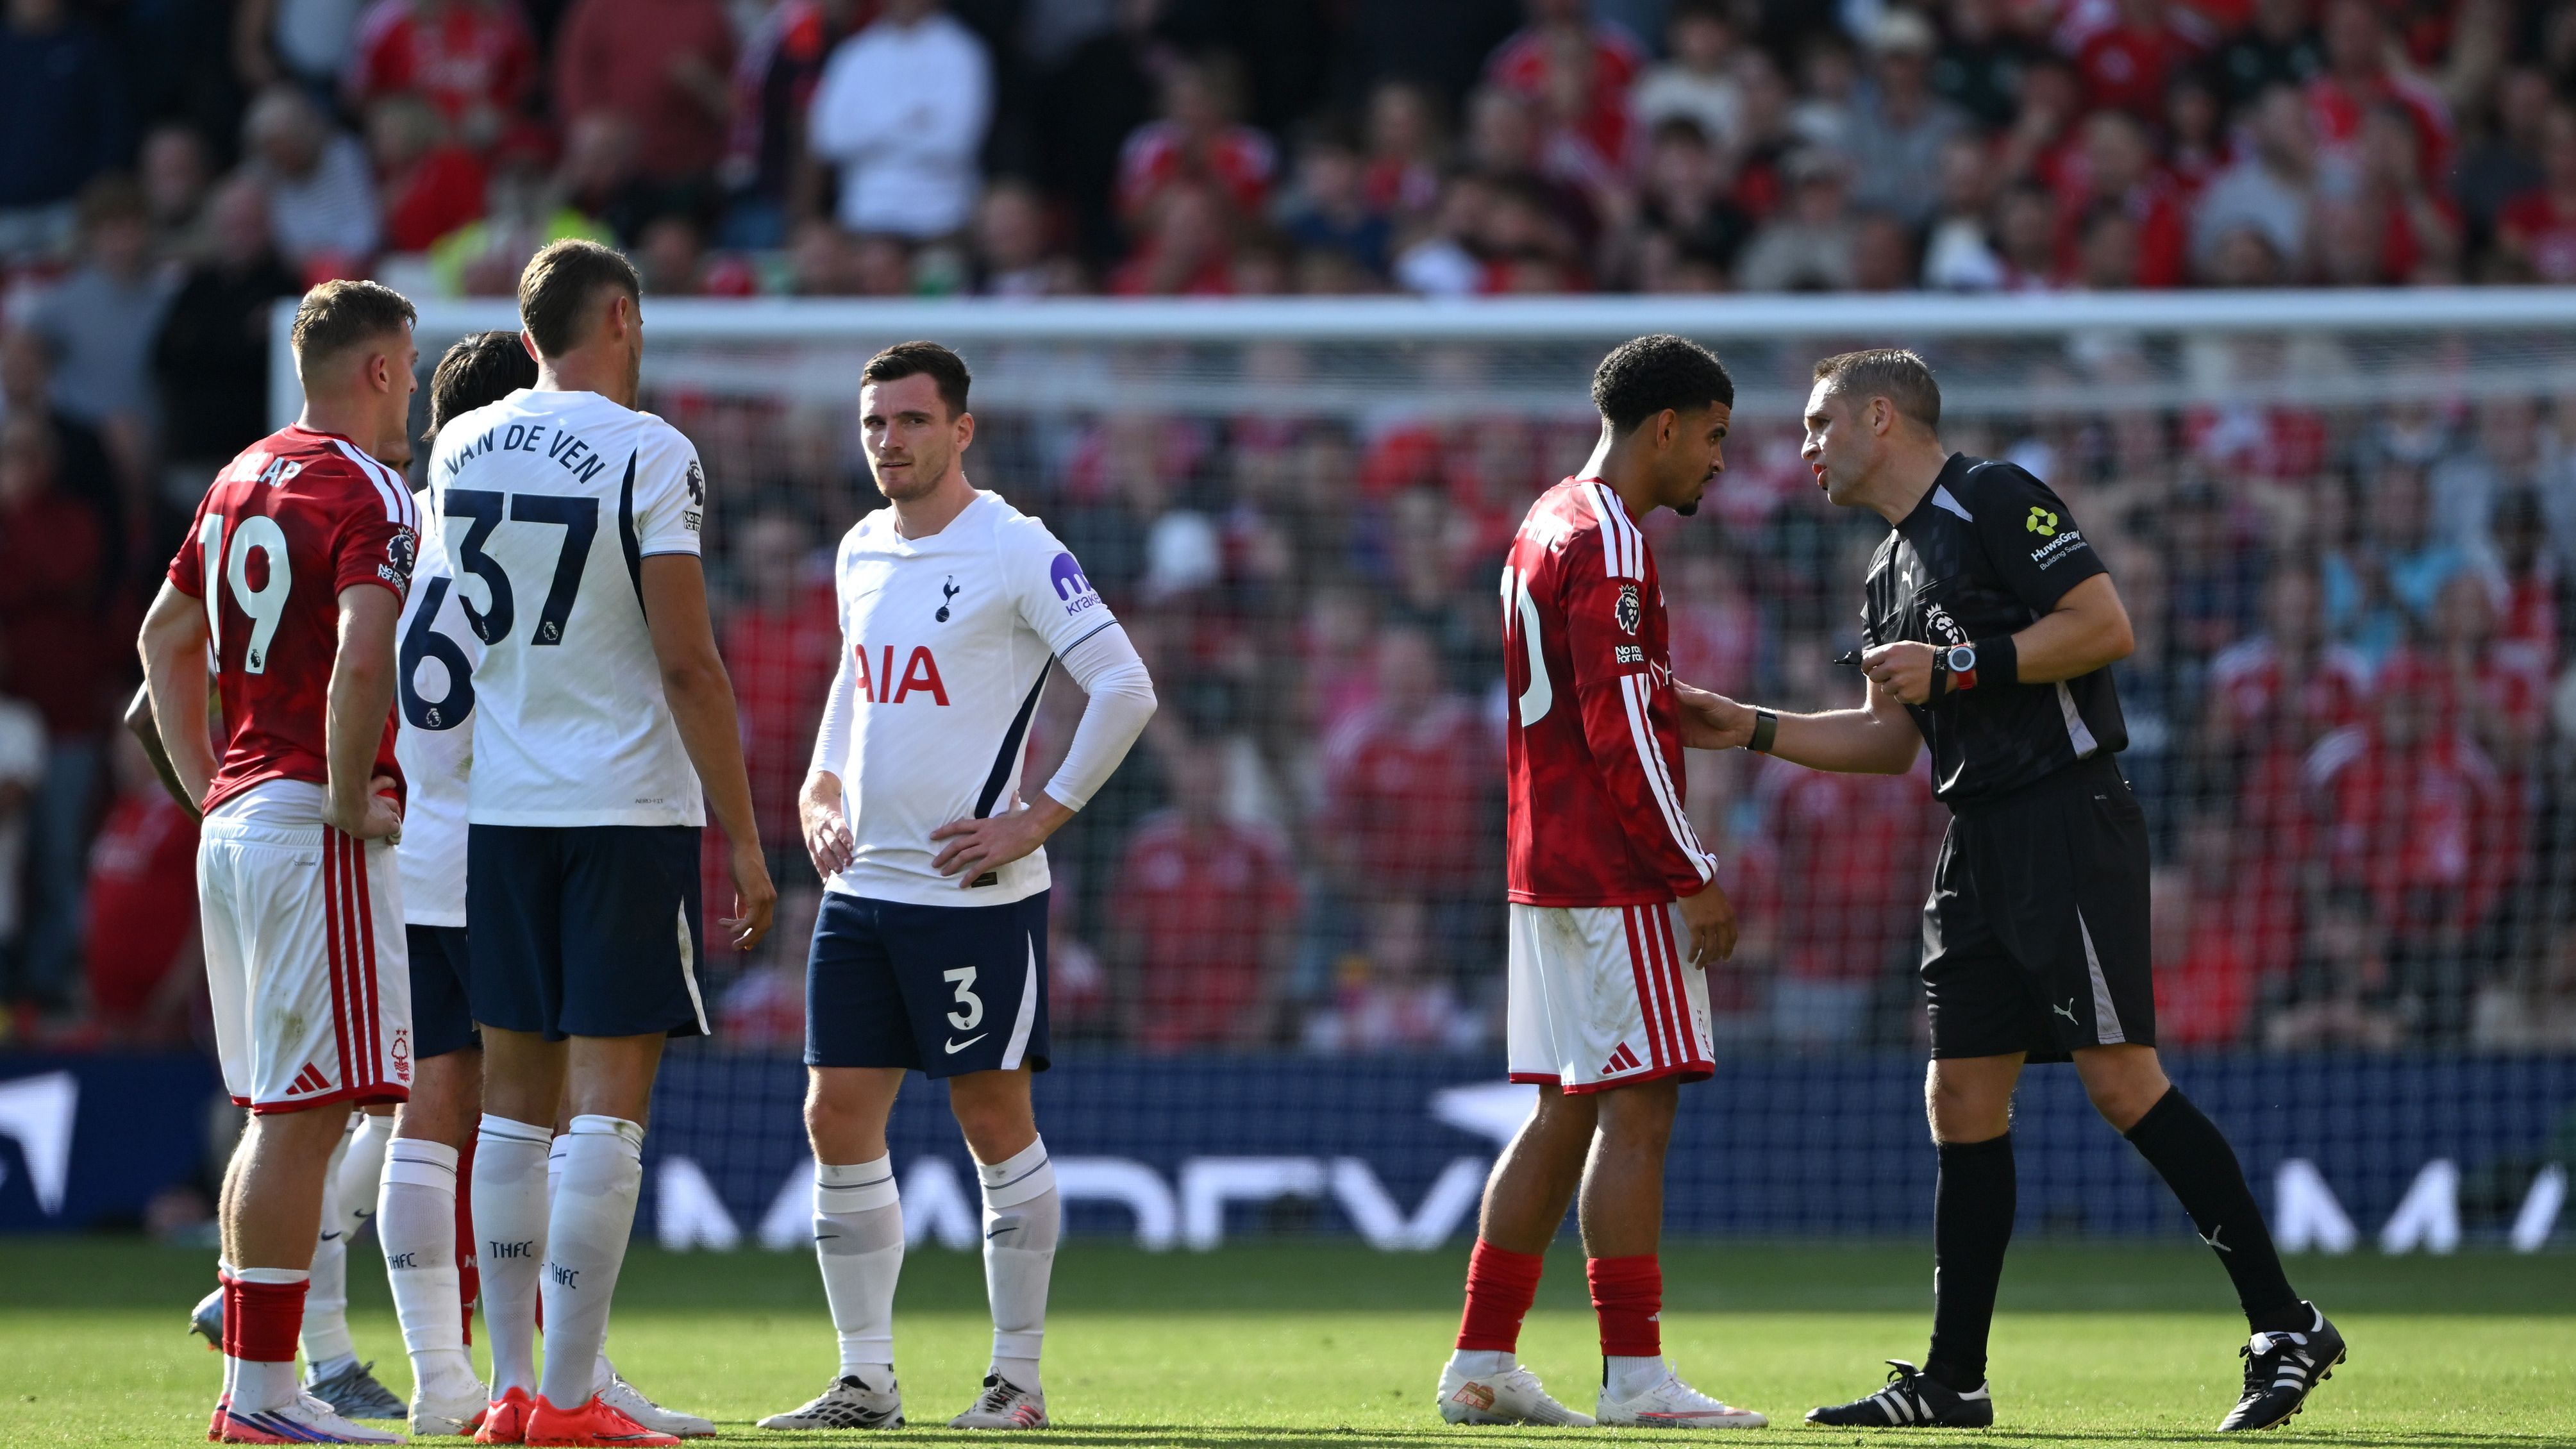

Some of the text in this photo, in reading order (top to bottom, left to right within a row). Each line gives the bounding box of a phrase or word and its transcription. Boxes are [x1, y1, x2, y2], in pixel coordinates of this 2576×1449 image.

[444, 424, 605, 484] VAN DE VEN
[444, 489, 600, 646] 37
[2031, 530, 2080, 562] HuwsGray
[2039, 551, 2066, 571] Building
[199, 514, 291, 674] 19
[399, 576, 476, 731] 6
[1615, 645, 1630, 655] No
[855, 644, 950, 706] AIA
[944, 966, 983, 1030] 3
[387, 1252, 417, 1270] THFC
[490, 1241, 533, 1259] THFC
[551, 1262, 580, 1289] THFC
